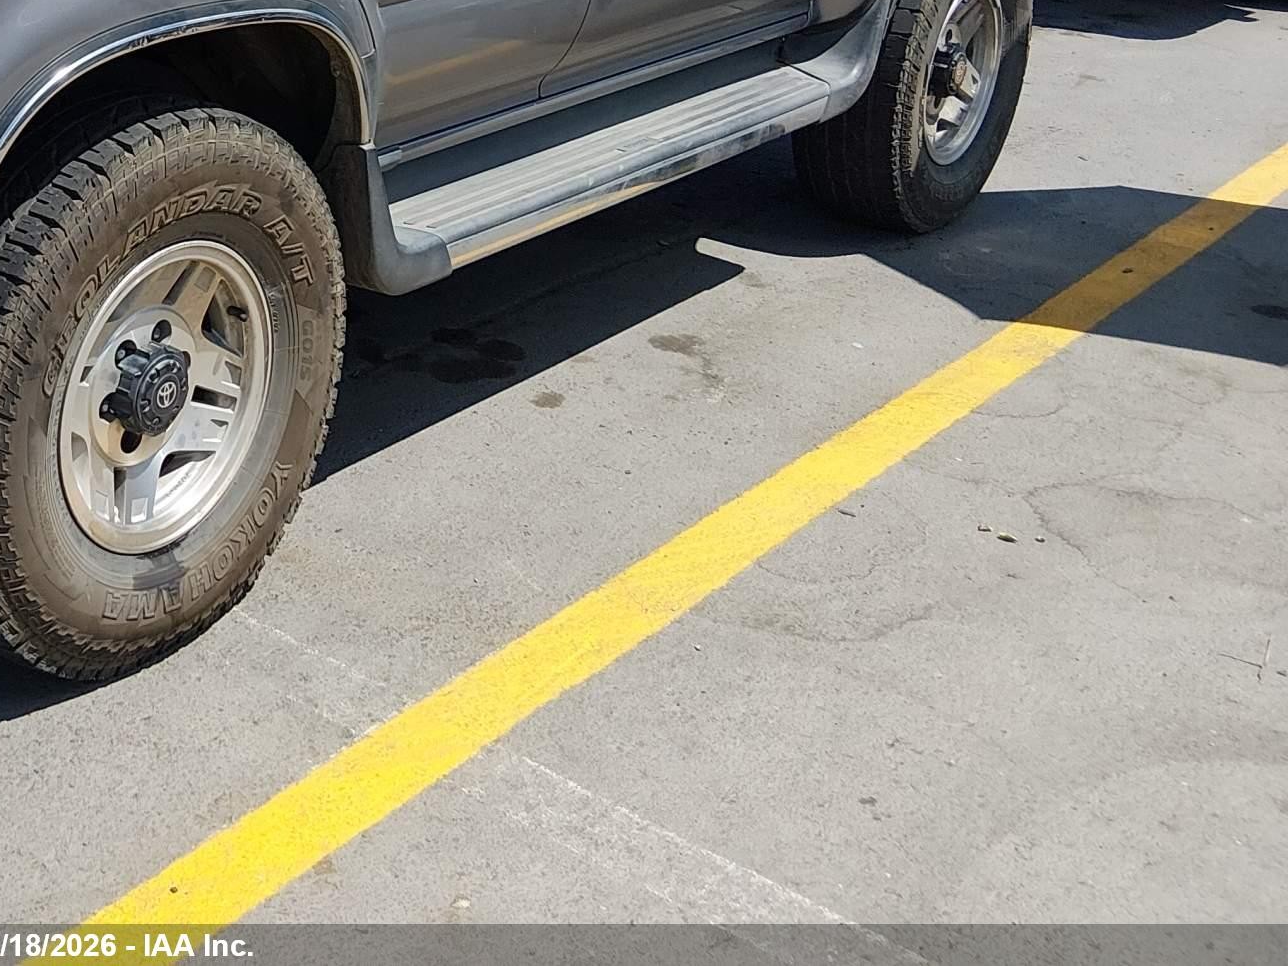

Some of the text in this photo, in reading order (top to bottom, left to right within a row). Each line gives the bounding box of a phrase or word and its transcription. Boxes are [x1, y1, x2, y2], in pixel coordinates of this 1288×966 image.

[40, 186, 314, 399] GEOLANDAR A/T
[101, 460, 294, 622] YOKOHAMA
